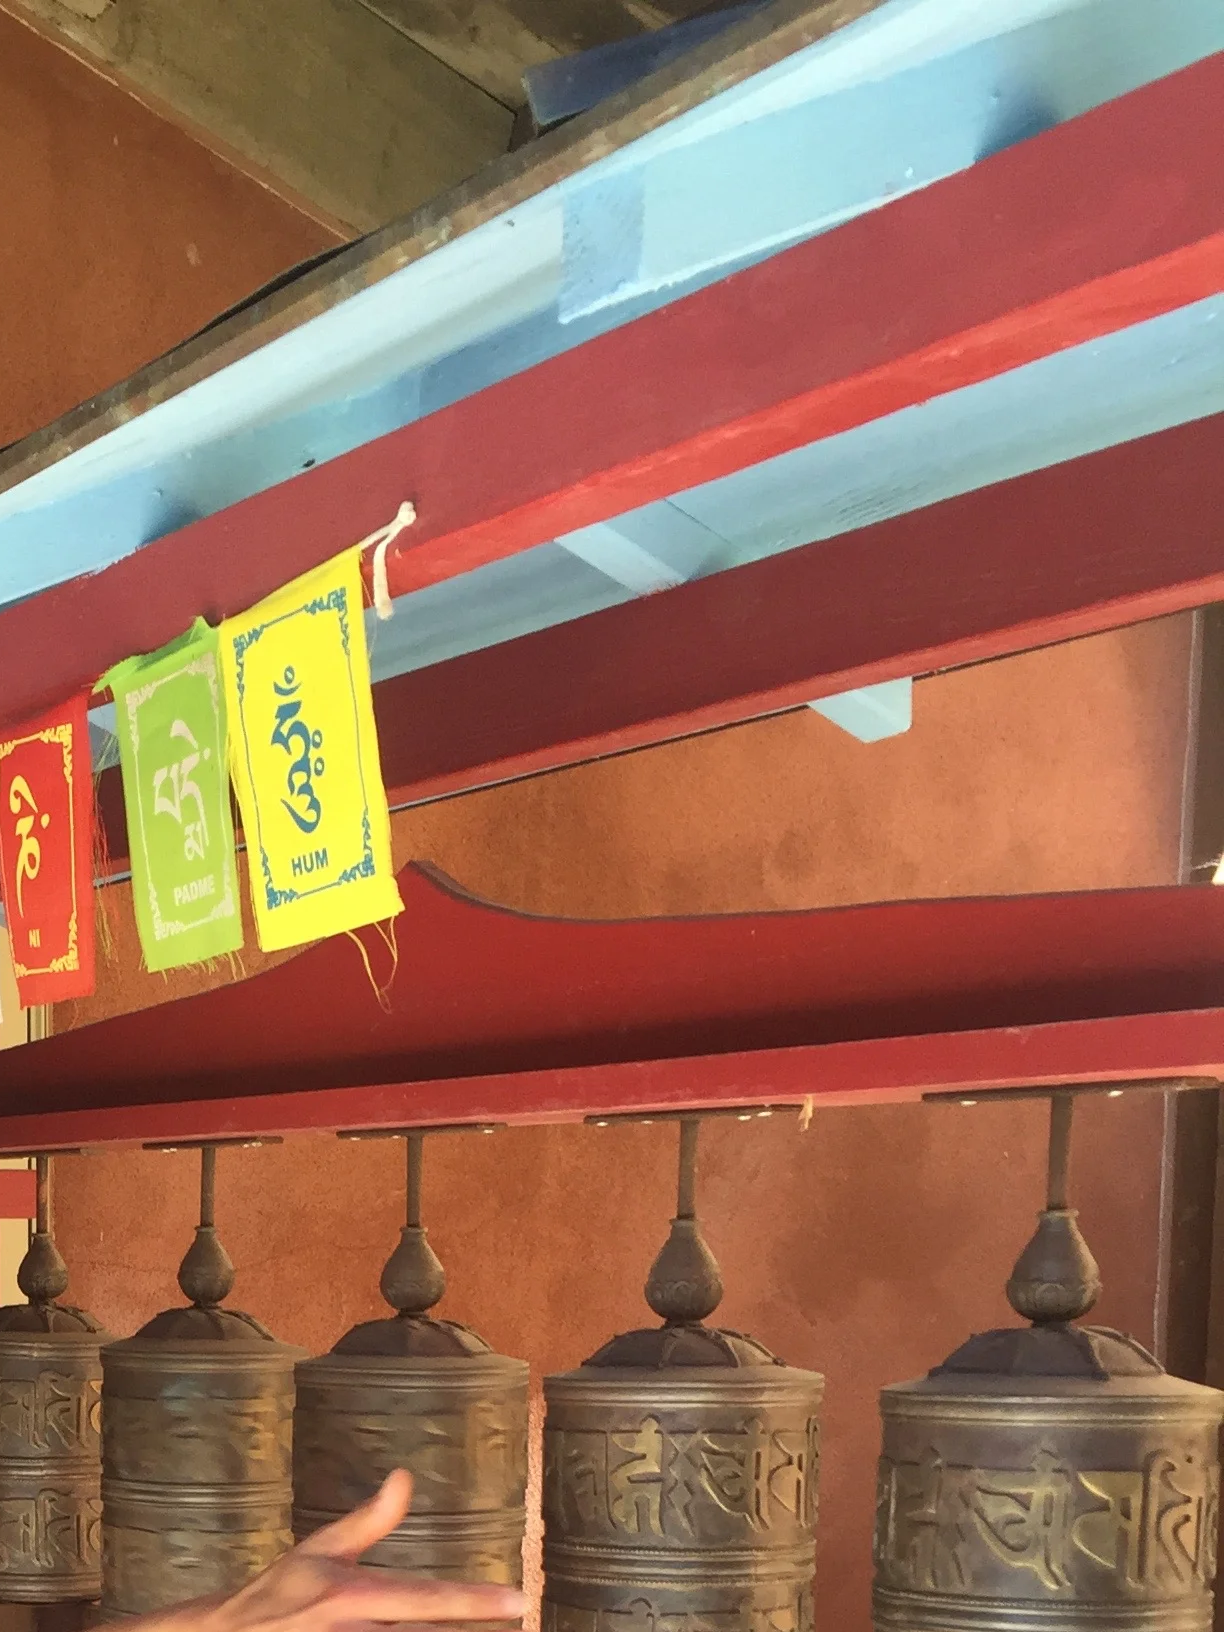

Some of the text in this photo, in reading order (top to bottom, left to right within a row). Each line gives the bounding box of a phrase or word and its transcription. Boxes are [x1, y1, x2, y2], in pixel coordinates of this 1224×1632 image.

[290, 847, 329, 878] HUM
[173, 873, 216, 906] PADME
[28, 928, 41, 948] NI
